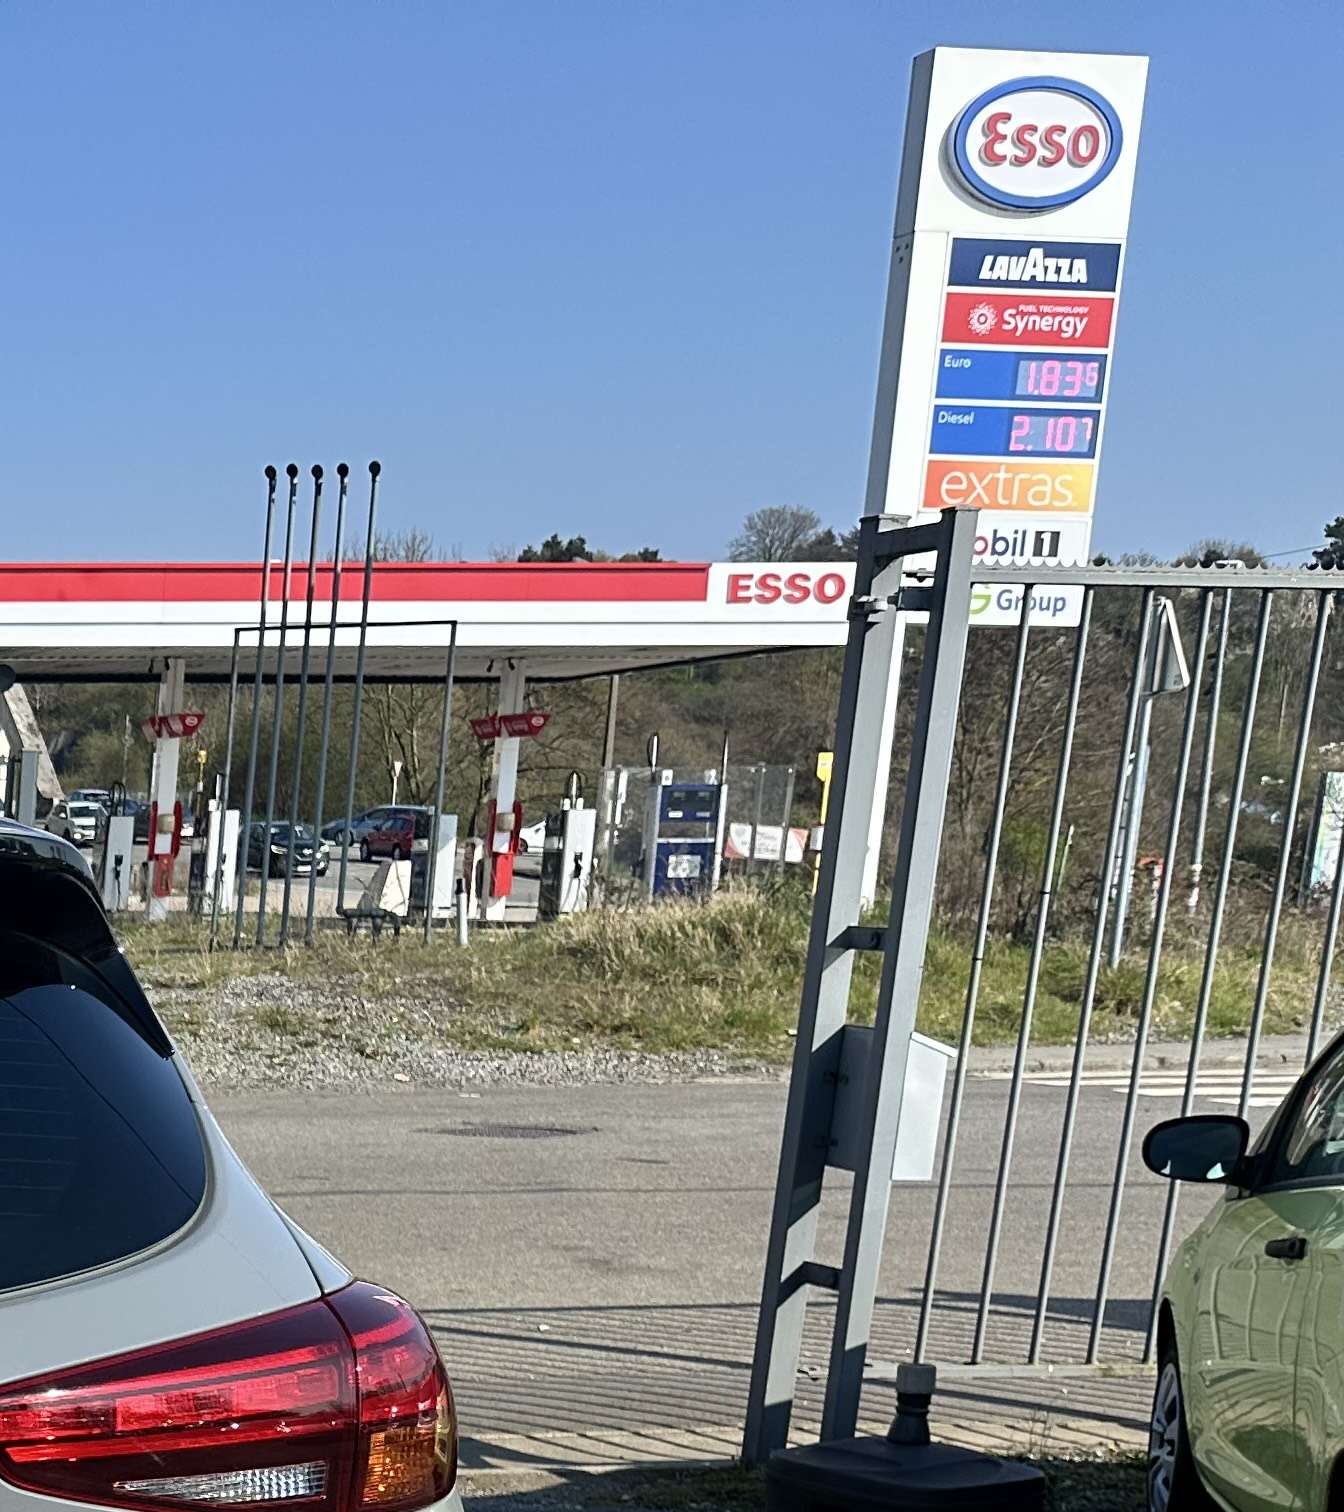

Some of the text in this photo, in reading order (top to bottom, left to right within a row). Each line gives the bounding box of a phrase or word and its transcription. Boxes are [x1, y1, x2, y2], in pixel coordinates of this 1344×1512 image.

[978, 248, 1088, 283] LAVAZZA
[1002, 308, 1088, 338] Synergy
[944, 354, 972, 368] Euro
[937, 411, 974, 424] Diesel
[940, 464, 1074, 507] extras
[972, 529, 1027, 557] obil
[726, 573, 846, 604] ESSO
